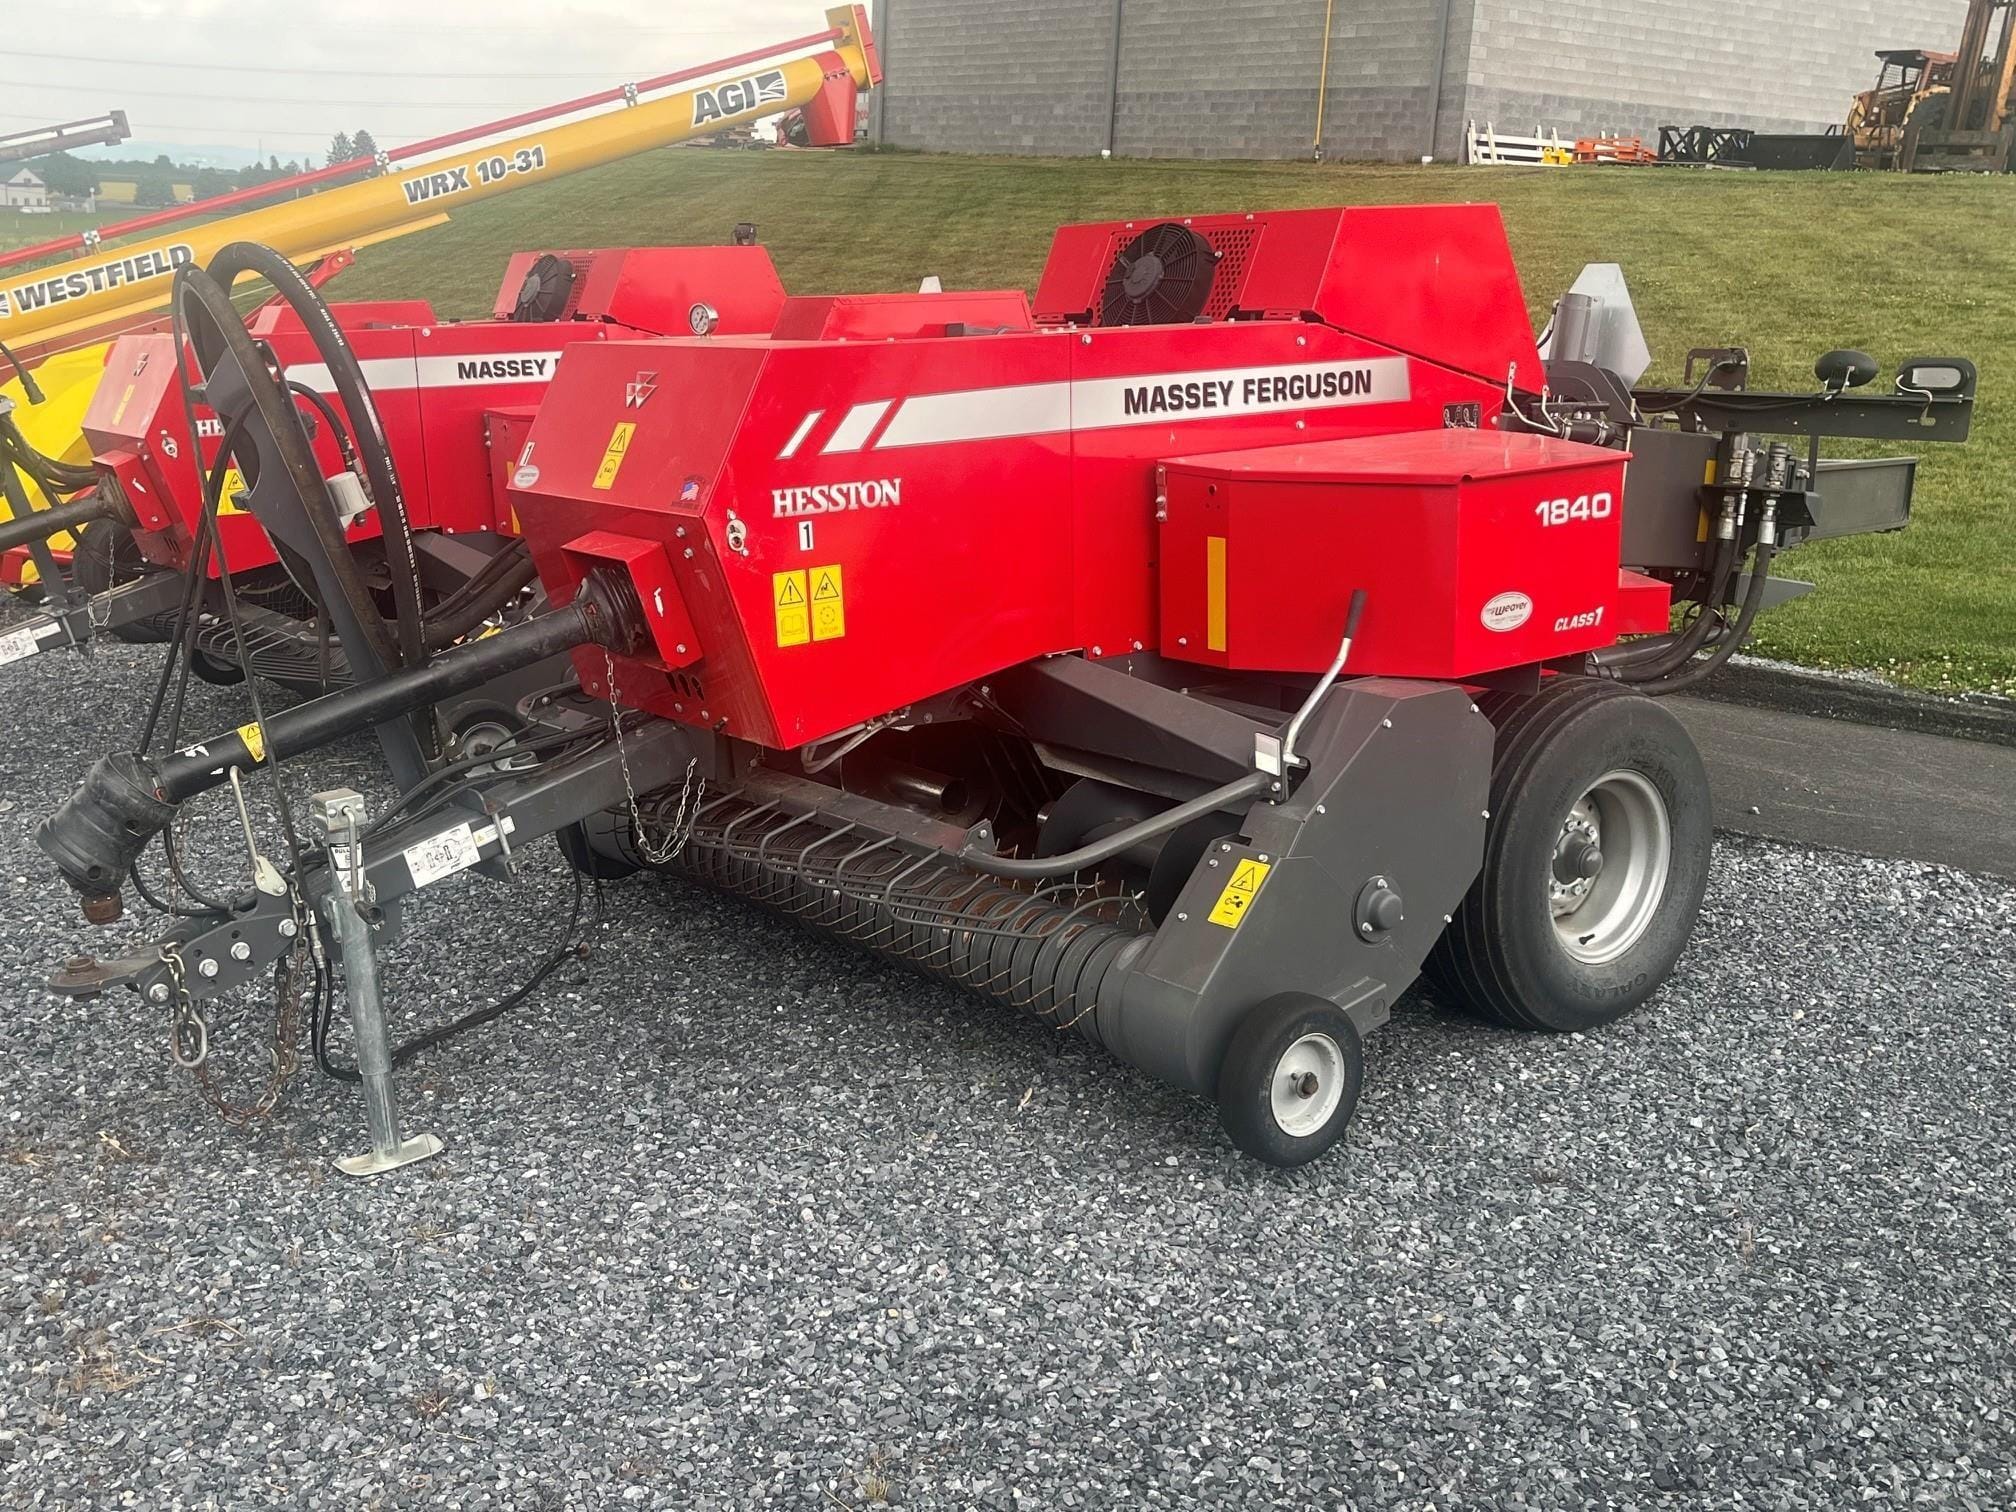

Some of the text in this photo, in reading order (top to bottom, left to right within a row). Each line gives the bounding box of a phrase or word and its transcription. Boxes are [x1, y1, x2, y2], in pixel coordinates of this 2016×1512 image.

[693, 79, 756, 125] AGI
[476, 146, 544, 183] 10-31
[403, 167, 470, 203] WRX
[13, 244, 193, 312] WESTFIELD
[457, 359, 547, 380] MASSEY
[1124, 369, 1373, 415] MASSEY FERGUSON
[771, 478, 902, 518] HESSTON
[1535, 492, 1612, 528] 1840
